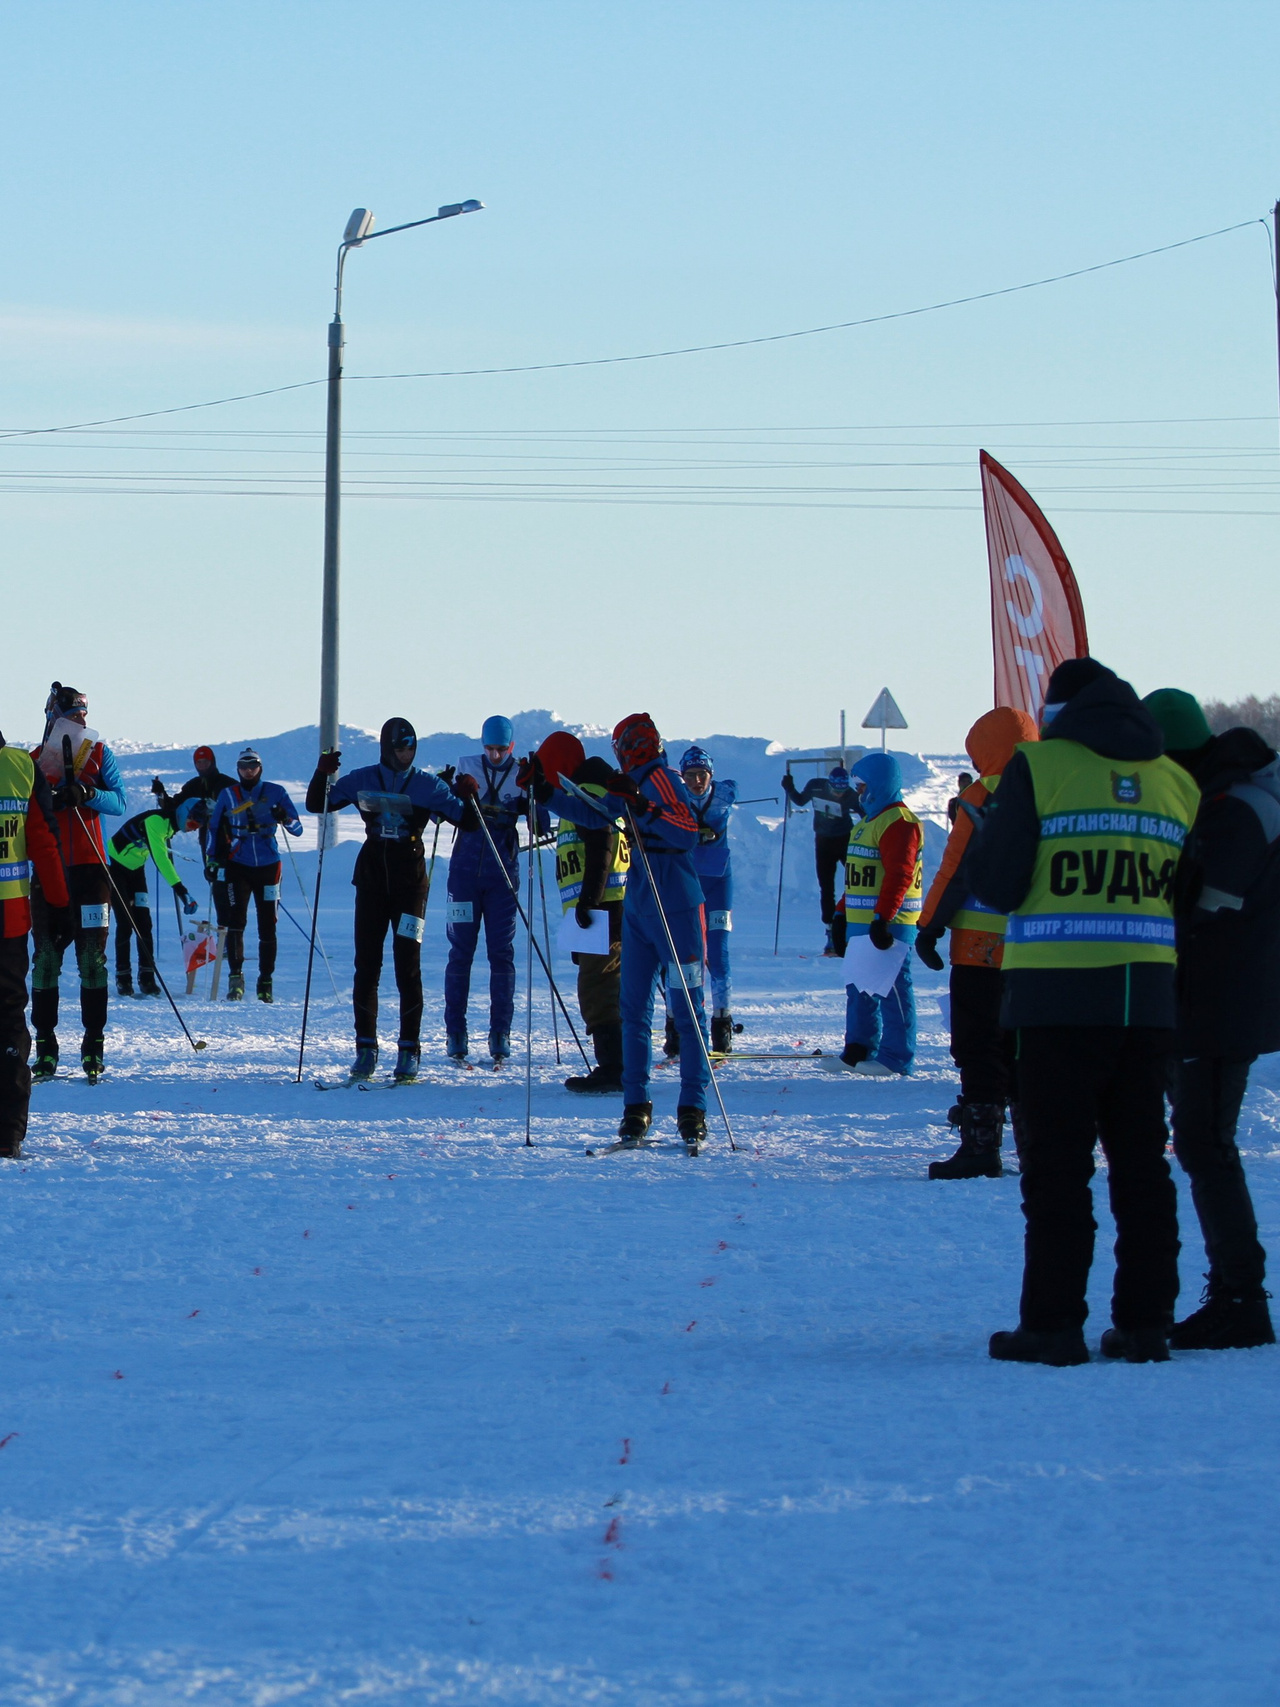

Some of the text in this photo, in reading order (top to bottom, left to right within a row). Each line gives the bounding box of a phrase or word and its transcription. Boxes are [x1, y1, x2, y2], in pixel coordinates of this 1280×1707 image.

[1050, 849, 1176, 904] СУДЬЯ
[452, 909, 465, 917] 17.1
[1023, 920, 1061, 937] ЦЕНТР
[1064, 919, 1123, 936] ЗИМНИХ
[1126, 920, 1162, 938] ВИДОВ
